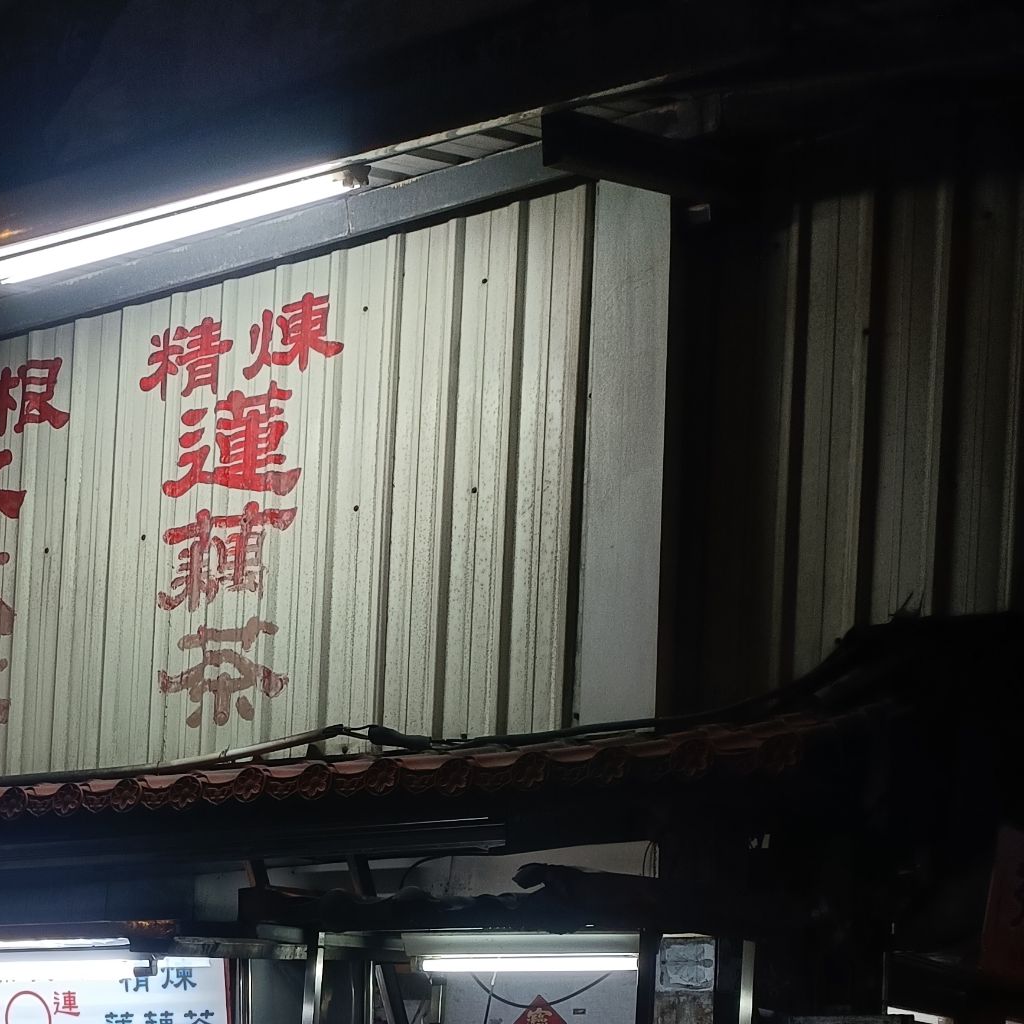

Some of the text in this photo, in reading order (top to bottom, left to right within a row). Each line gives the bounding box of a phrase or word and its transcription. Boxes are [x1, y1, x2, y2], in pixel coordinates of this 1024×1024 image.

[139, 291, 345, 402] 精煉
[157, 380, 302, 729] 蓮藕茶
